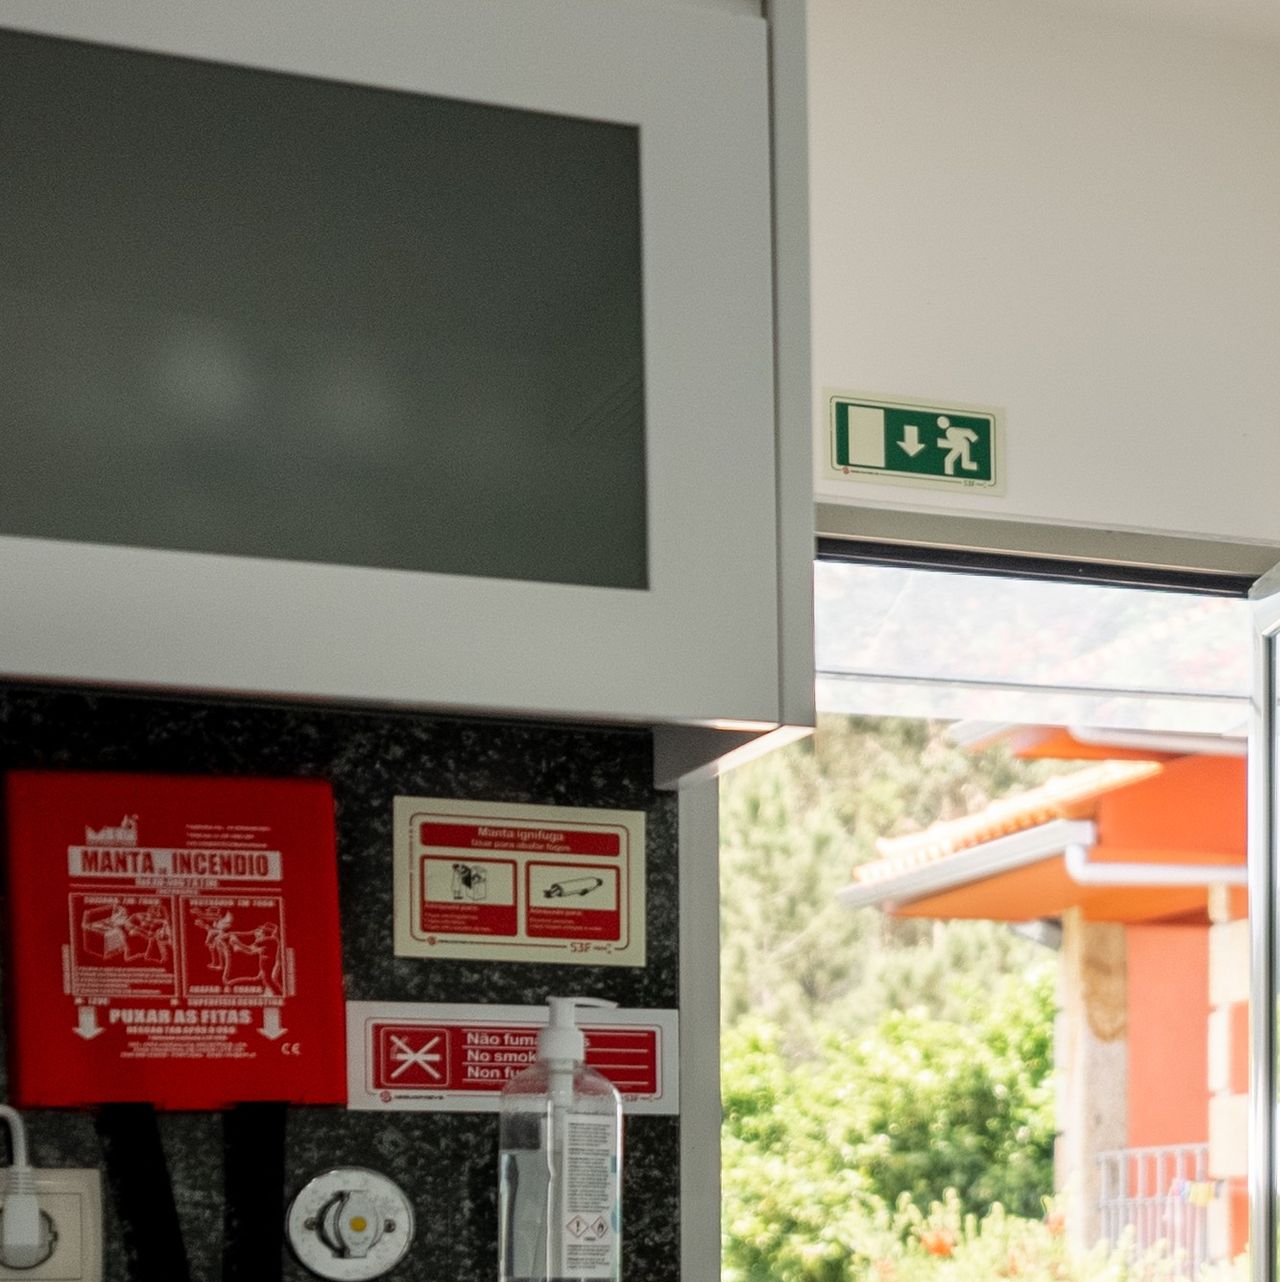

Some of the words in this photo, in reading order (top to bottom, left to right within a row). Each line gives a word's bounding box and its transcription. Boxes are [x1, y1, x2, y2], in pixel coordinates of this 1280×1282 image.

[478, 827, 514, 838] Manta
[82, 850, 155, 874] MANTA
[172, 852, 269, 876] INCENDIO
[109, 1008, 171, 1025] PUXAR
[174, 1009, 199, 1024] AS
[201, 1009, 253, 1026] FITAS
[467, 1031, 500, 1046] Não
[467, 1049, 493, 1062] No
[494, 1050, 537, 1062] smok
[467, 1066, 501, 1079] Non
